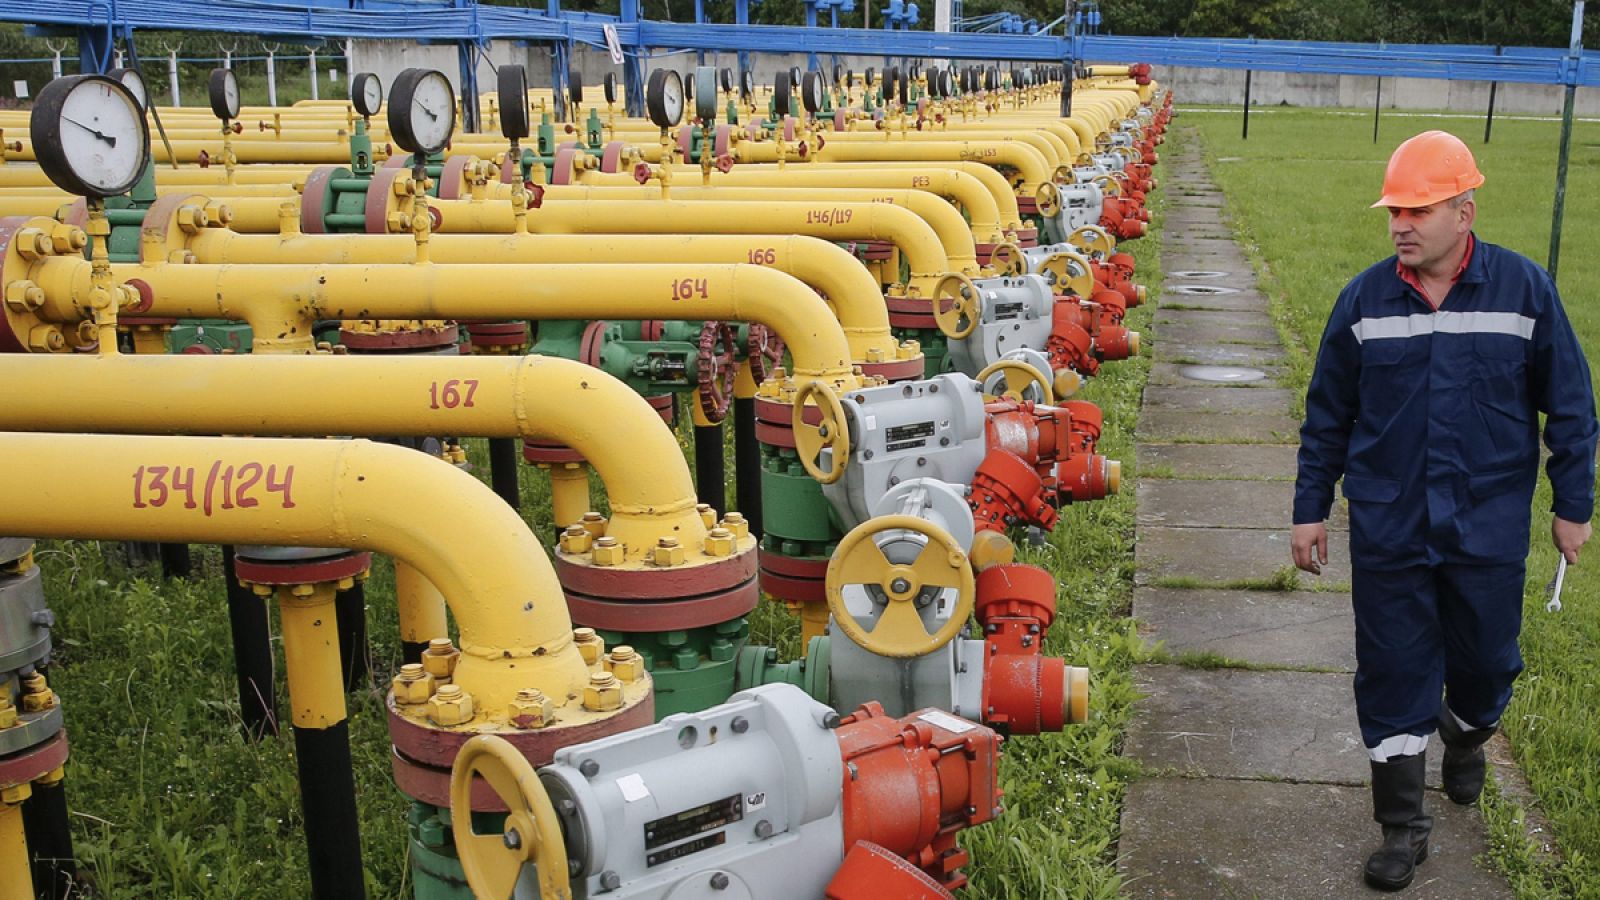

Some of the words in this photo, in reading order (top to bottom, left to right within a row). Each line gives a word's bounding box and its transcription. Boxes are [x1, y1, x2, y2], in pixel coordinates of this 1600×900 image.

[747, 248, 775, 264] 166
[671, 278, 708, 301] 164
[429, 379, 479, 409] 167
[133, 460, 295, 517] 134/124
